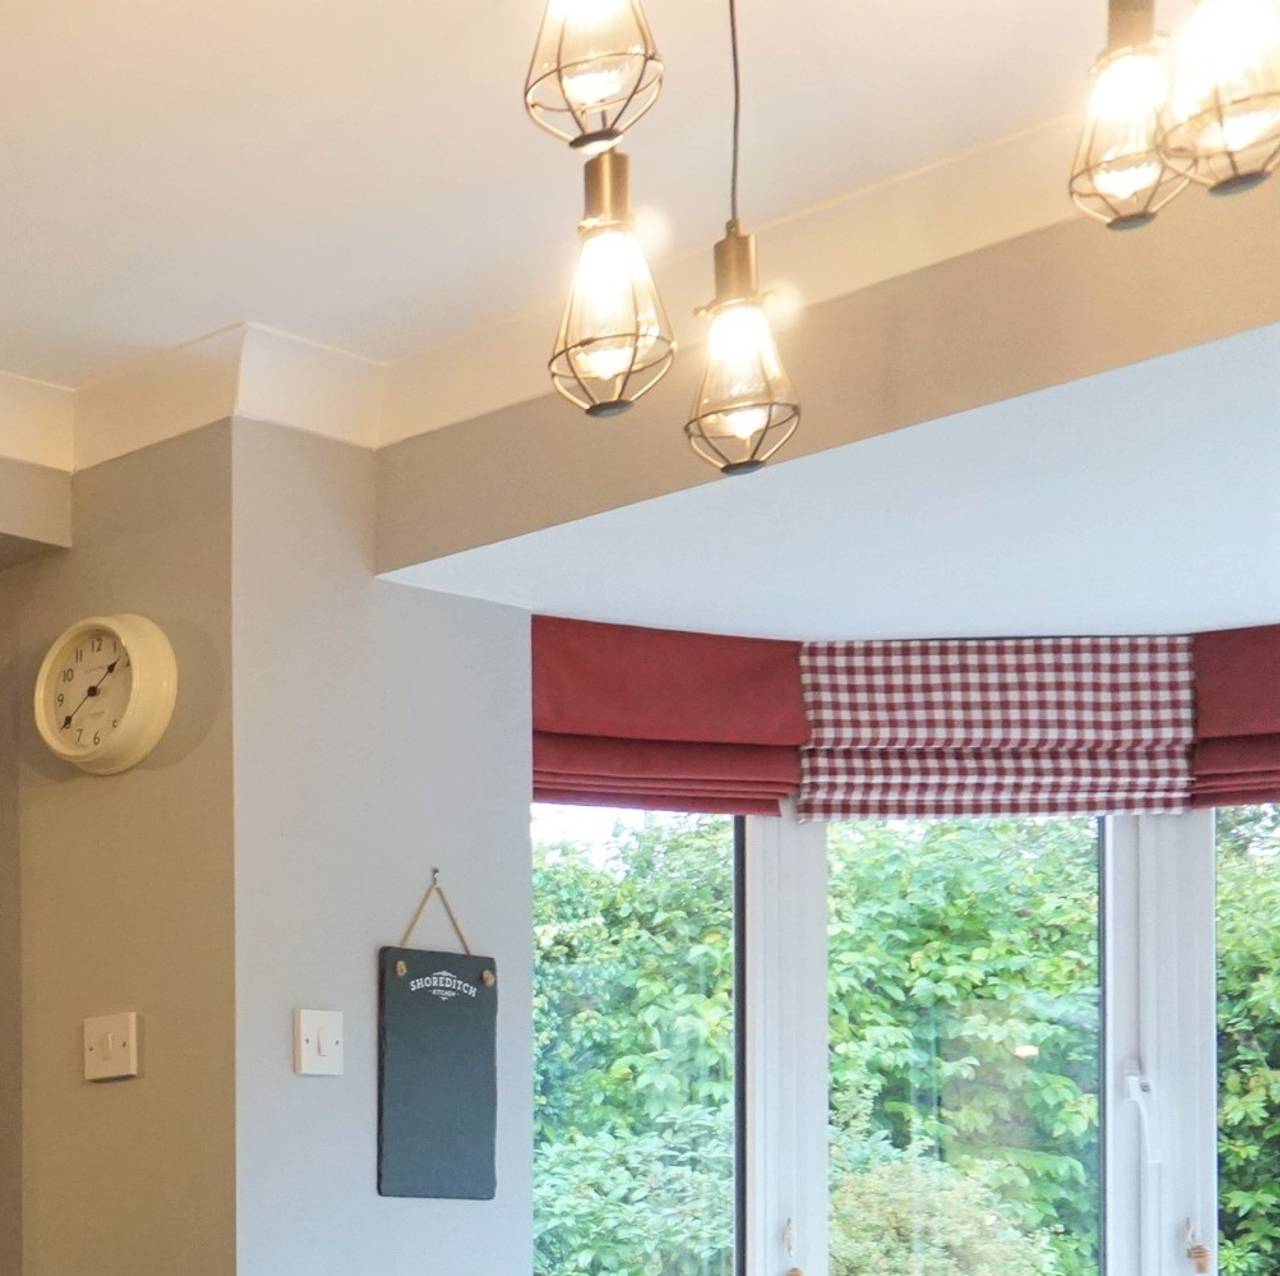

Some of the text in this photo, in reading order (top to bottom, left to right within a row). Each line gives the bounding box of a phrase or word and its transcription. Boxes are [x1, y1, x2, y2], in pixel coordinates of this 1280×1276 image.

[91, 638, 103, 653] 12
[75, 647, 84, 664] 11
[63, 668, 74, 683] 10
[57, 693, 65, 708] 9
[76, 730, 84, 743] 7
[93, 730, 101, 746] 6
[409, 976, 478, 998] SHOREDITCH
